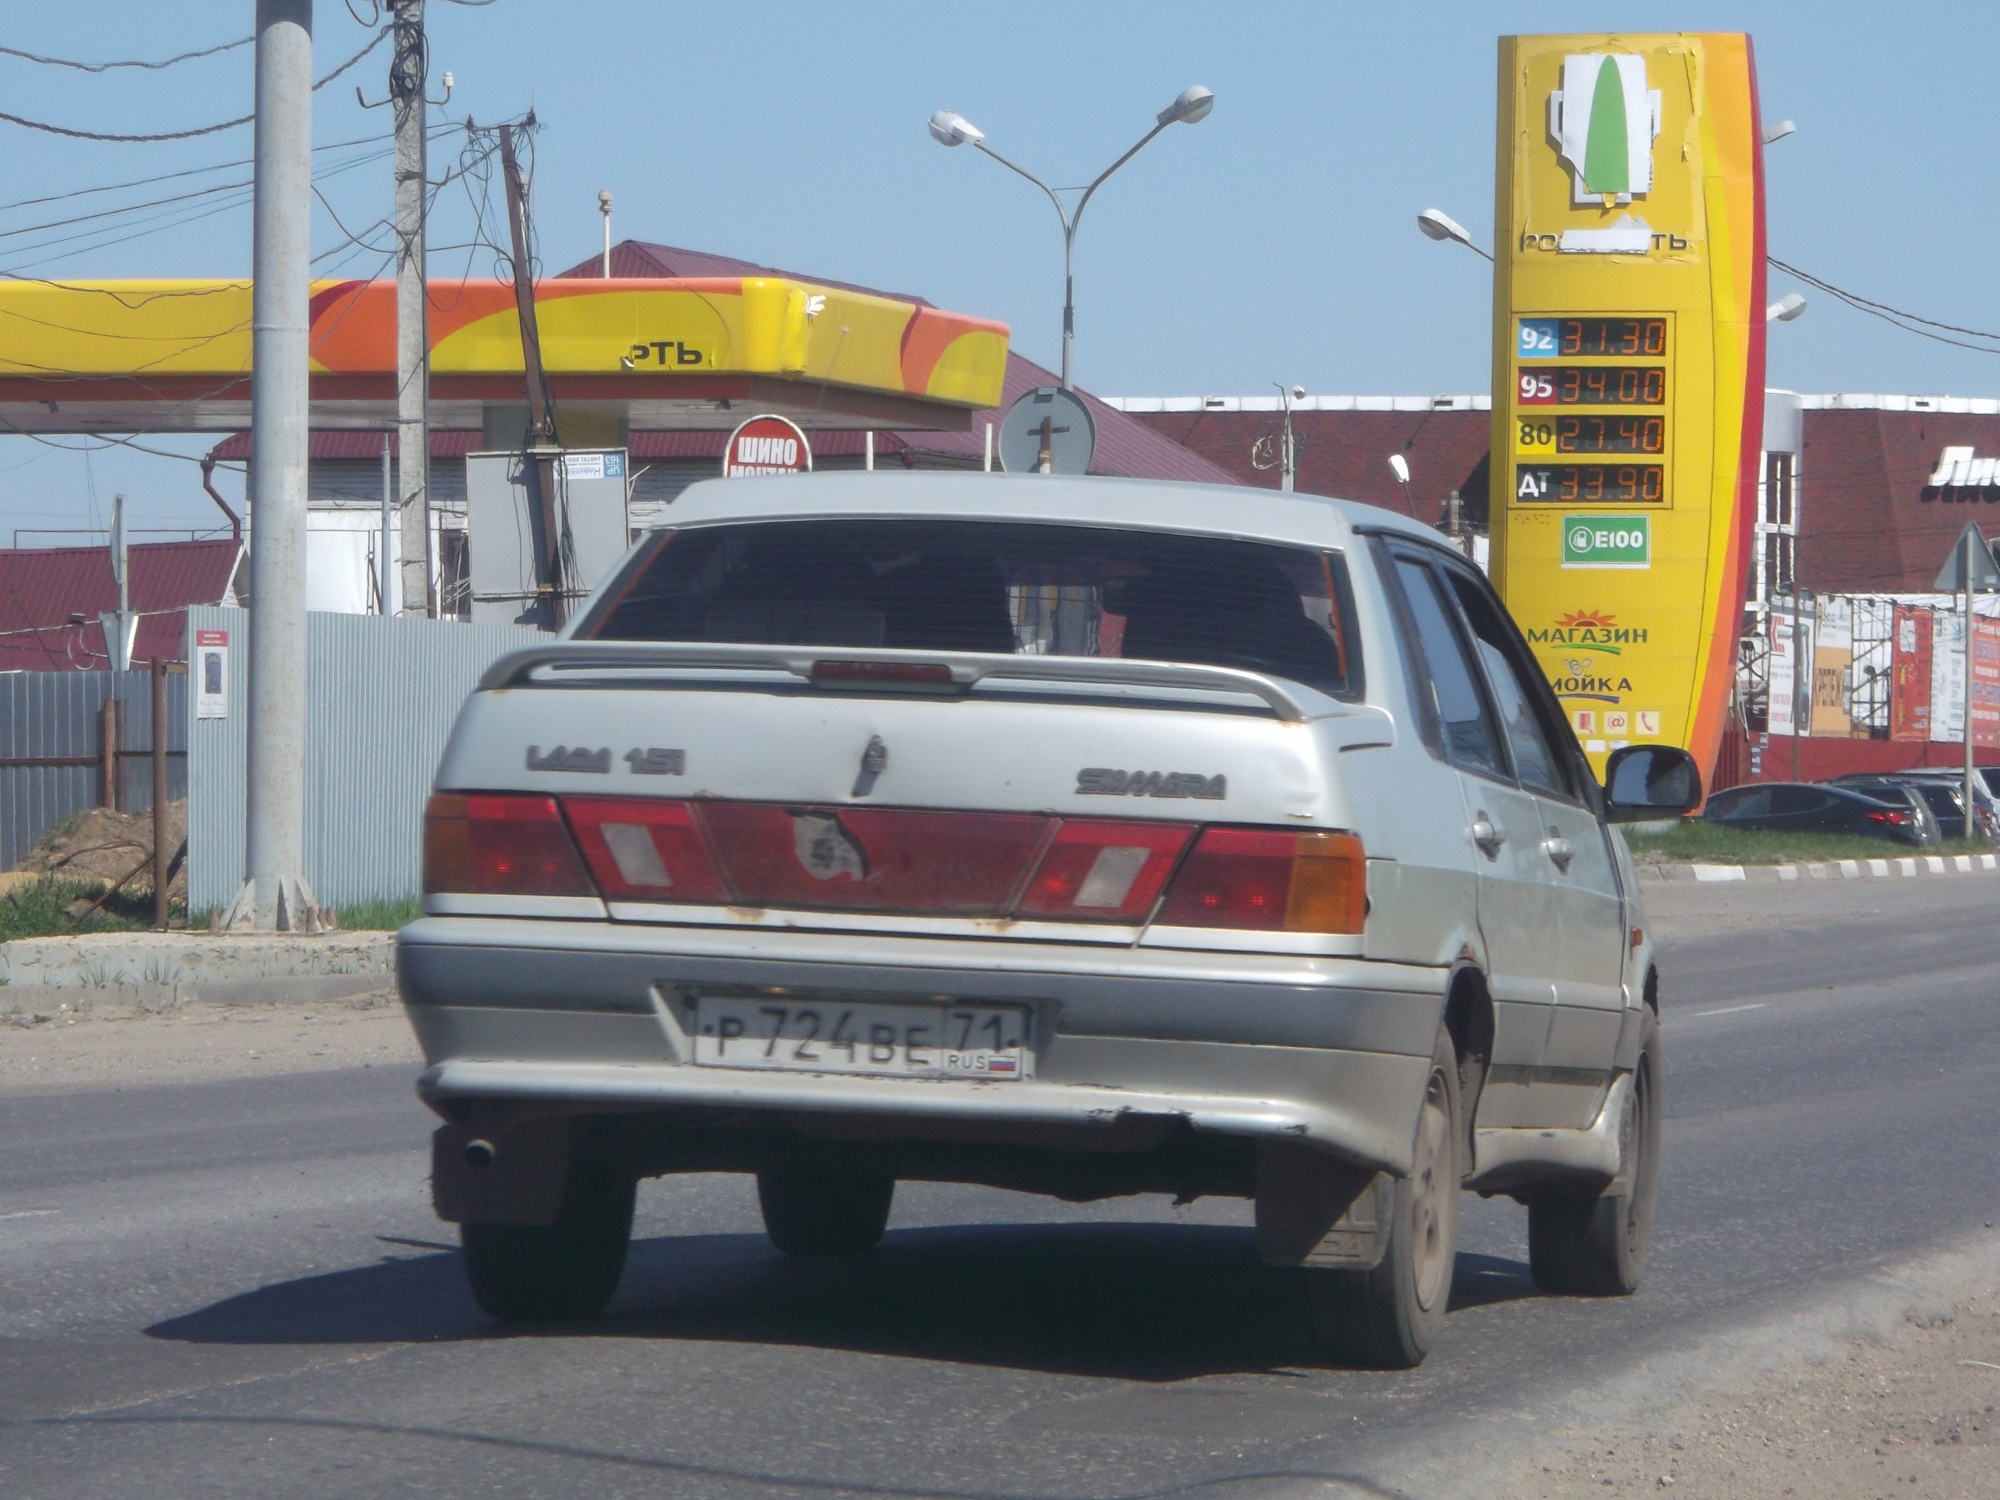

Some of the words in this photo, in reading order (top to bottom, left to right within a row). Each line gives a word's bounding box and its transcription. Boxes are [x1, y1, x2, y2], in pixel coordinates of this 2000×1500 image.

[1521, 326, 1553, 350] 92
[1563, 321, 1665, 354] 31.30
[1520, 375, 1553, 398] 95
[1562, 369, 1664, 403] 34.00
[1519, 423, 1551, 446] 80
[1559, 418, 1664, 451] 27.40
[605, 455, 620, 464] 163
[737, 436, 798, 466] ШИНО
[1518, 471, 1550, 498] ДТ
[1559, 467, 1663, 500] 33.90
[1594, 530, 1643, 549] E100
[1527, 627, 1648, 643] МАГАЗИН
[952, 1011, 1002, 1053] 71
[947, 1053, 986, 1071] RUS
